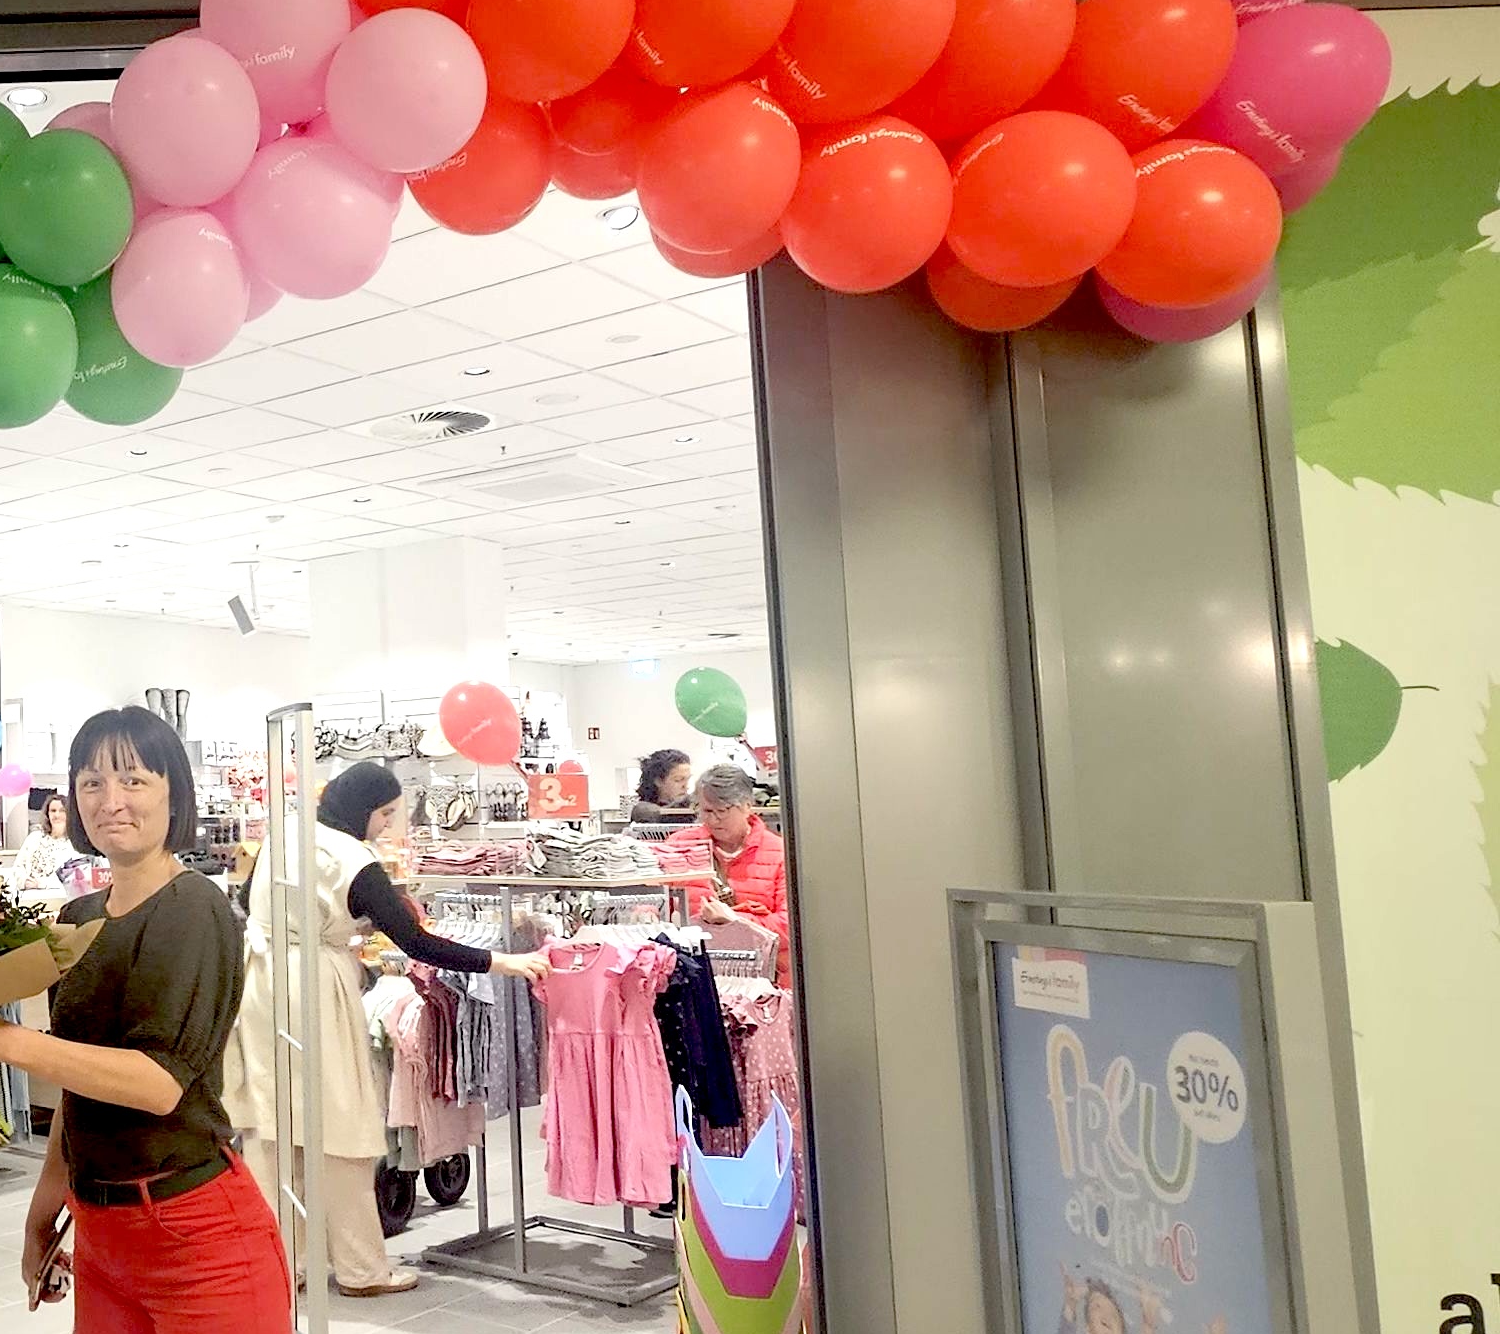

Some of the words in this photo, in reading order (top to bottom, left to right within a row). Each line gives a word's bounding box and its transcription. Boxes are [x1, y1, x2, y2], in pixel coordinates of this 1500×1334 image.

[254, 44, 296, 66] family
[787, 60, 827, 100] family
[820, 134, 868, 158] family
[1174, 1064, 1240, 1113] 30%
